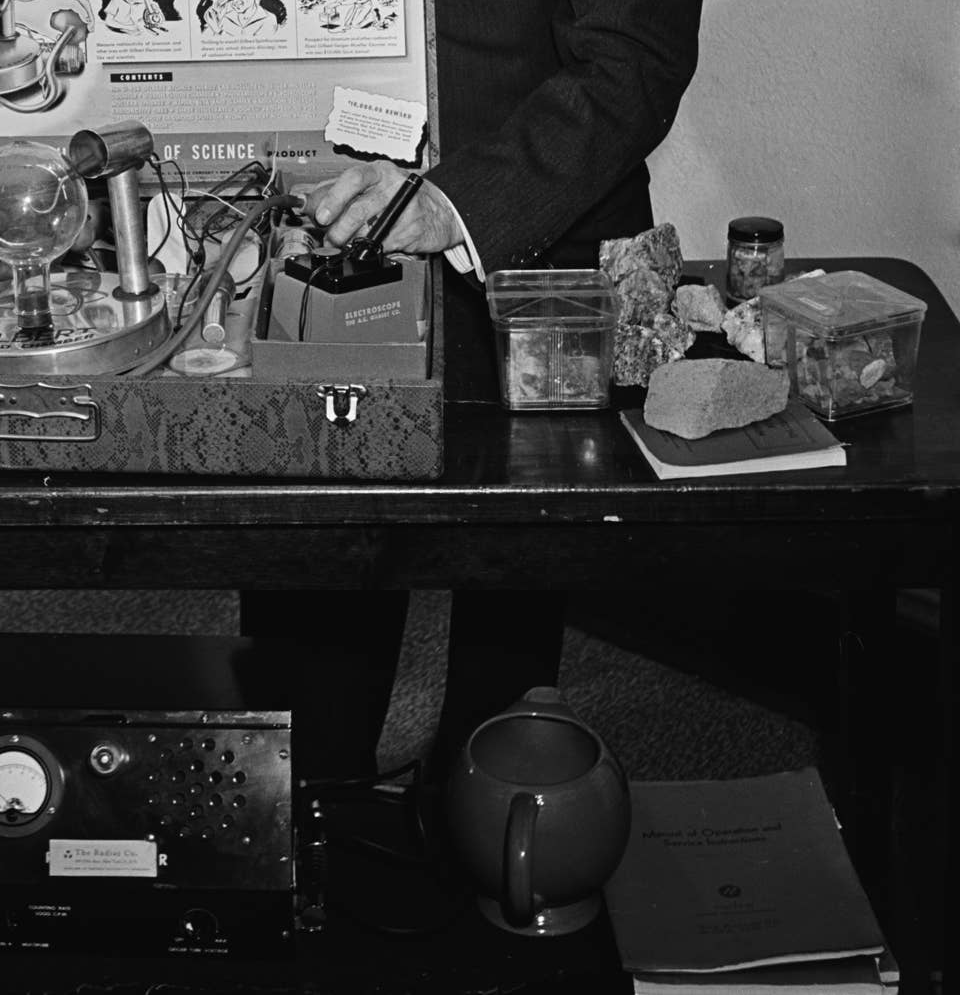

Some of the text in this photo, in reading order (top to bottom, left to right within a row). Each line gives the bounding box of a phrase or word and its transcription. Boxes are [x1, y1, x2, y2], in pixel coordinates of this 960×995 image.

[119, 73, 164, 82] CONTENTS
[164, 144, 181, 160] OF
[192, 143, 256, 160] SCIENCE
[344, 300, 401, 319] ELECTROSCOPE
